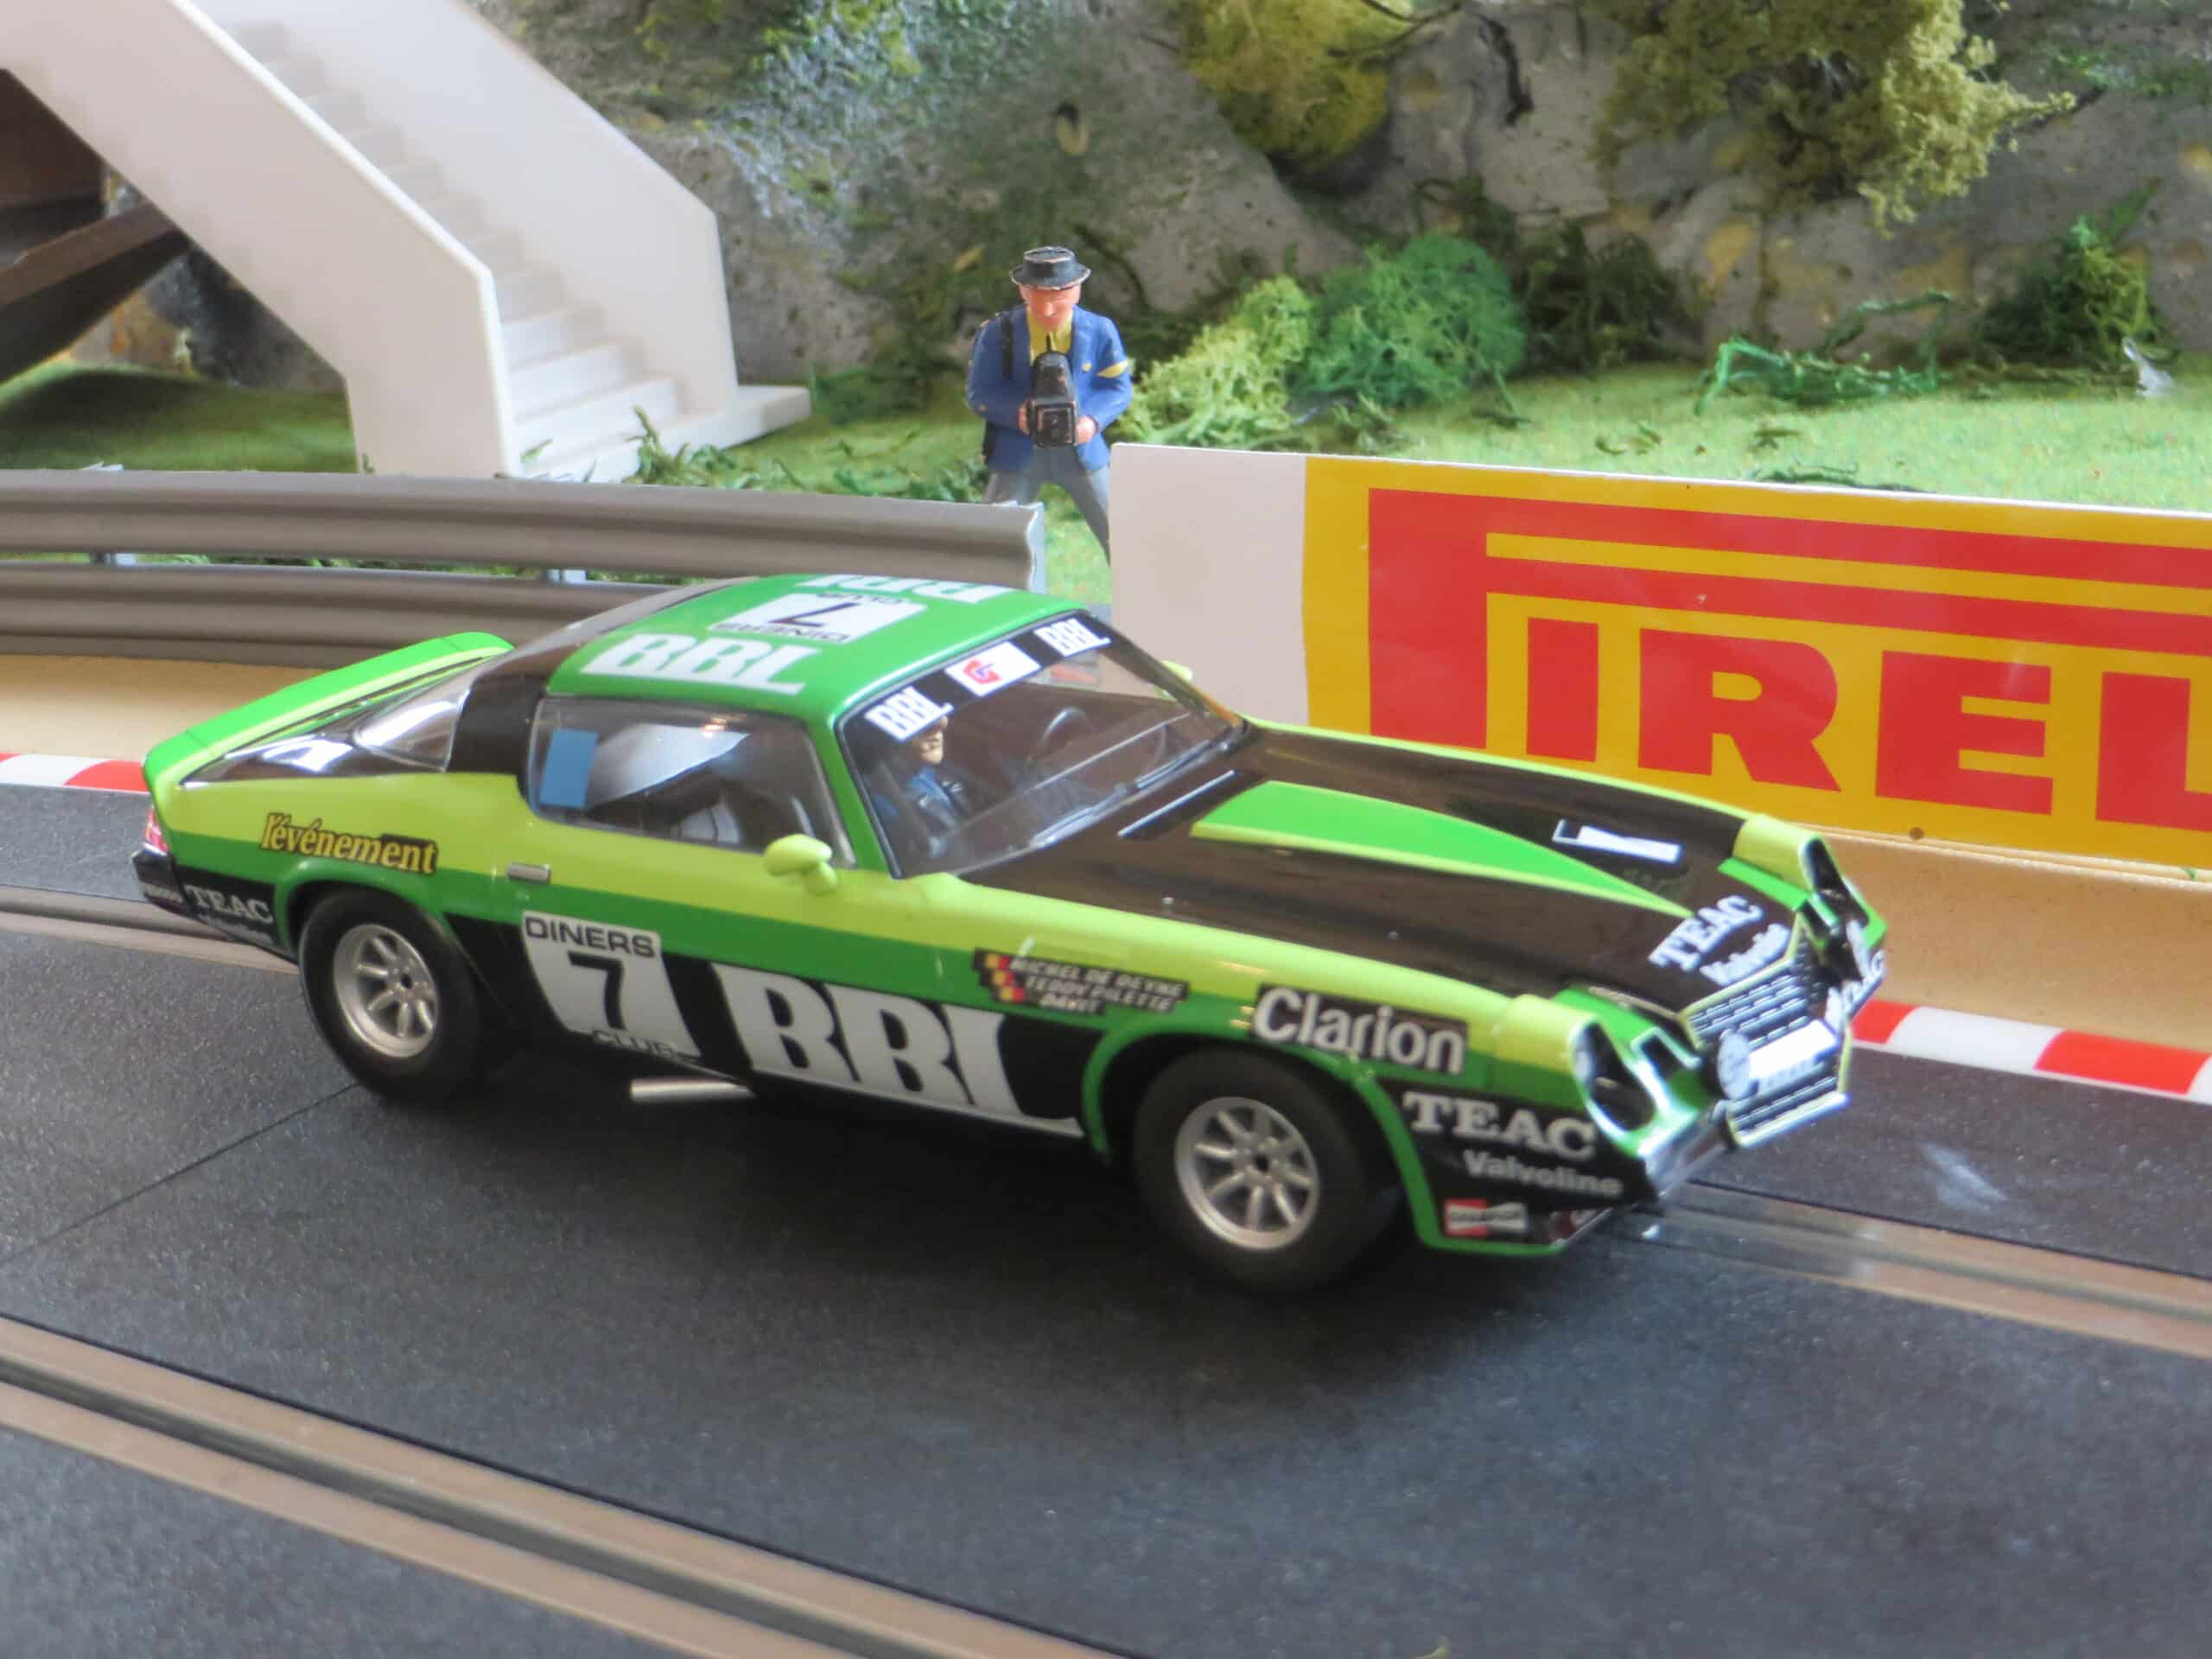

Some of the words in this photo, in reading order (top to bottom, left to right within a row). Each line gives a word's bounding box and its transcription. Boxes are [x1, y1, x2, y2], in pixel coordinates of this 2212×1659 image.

[767, 601, 866, 628] 7
[1033, 618, 1111, 657] BBL
[580, 634, 821, 696] BBL
[865, 686, 954, 741] BBL
[183, 884, 275, 925] TEAC
[1648, 894, 1764, 970] TEAC
[524, 917, 657, 958] DINERS
[568, 950, 626, 1030] 7
[1254, 987, 1466, 1074] Clarion
[1403, 1091, 1597, 1160] TEAC
[1463, 1149, 1624, 1197] Valvoline
